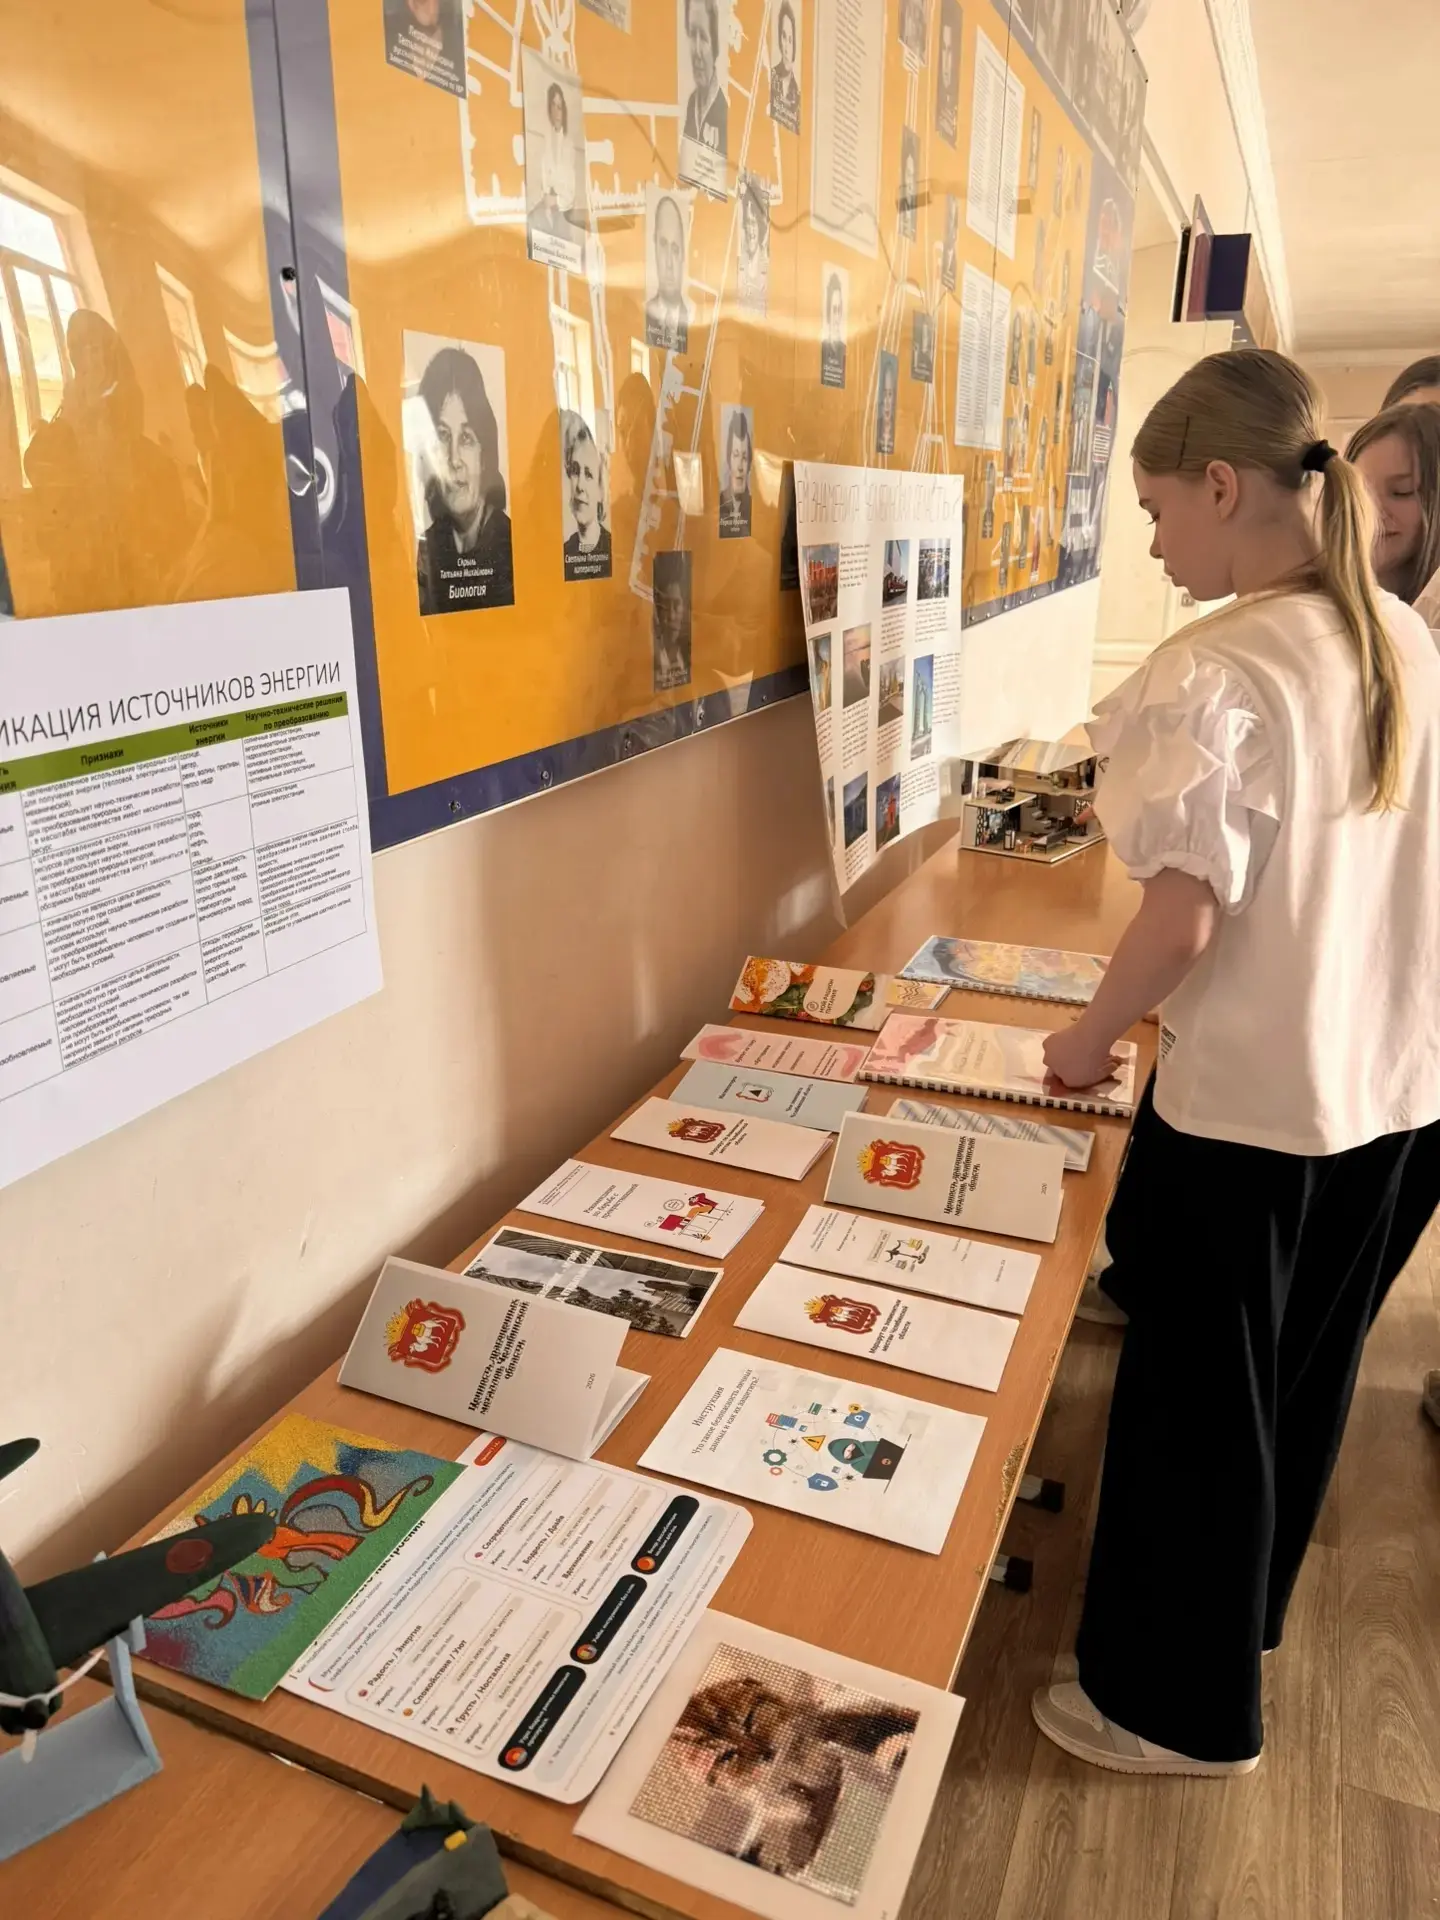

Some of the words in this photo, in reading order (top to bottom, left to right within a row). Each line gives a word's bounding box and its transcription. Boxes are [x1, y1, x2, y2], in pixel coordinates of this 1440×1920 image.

[440, 569, 462, 578] Татьяна
[463, 568, 494, 577] Михайловна
[457, 558, 476, 568] Скрыль
[449, 585, 486, 598] Биология
[109, 676, 255, 727] ИСТОЧНИКОВ
[261, 662, 341, 695] ЭНЕРГИИ
[245, 700, 313, 723] Научно-технические
[315, 694, 342, 707] решения
[263, 721, 271, 730] по
[273, 709, 329, 729] преобразованию
[188, 718, 228, 735] Источники
[195, 731, 225, 747] энергии
[80, 747, 123, 767] Признаки
[24, 798, 36, 808] для
[39, 789, 73, 804] получения
[31, 813, 56, 826] человек
[59, 804, 92, 819] использует
[94, 789, 149, 810] научно-технические
[40, 827, 76, 842] масштабах
[78, 814, 120, 832] человечества
[123, 809, 141, 819] имеют
[41, 814, 89, 833] преобразования
[91, 806, 121, 820] природных
[197, 895, 231, 914] температуры
[818, 1000, 827, 1012] МОЙ
[823, 978, 834, 1000] РАЦИОН
[824, 988, 838, 1014] ПИТАНИЯ
[596, 1195, 617, 1211] борьбе
[881, 1333, 894, 1351] местам
[888, 1305, 908, 1334] Челябинской
[896, 1320, 911, 1340] области
[467, 1362, 494, 1412] Ценность
[487, 1297, 520, 1365] драгоценных
[868, 1331, 886, 1354] Маршрут
[479, 1364, 505, 1415] металлов
[495, 1299, 530, 1366] Челябинской
[585, 1372, 596, 1389] 2026
[735, 1376, 761, 1406] защитить?
[690, 1385, 727, 1427] Инструкция
[690, 1442, 705, 1454] Что
[699, 1426, 716, 1443] такое
[709, 1388, 740, 1426] безопасность
[734, 1368, 754, 1389] личных
[725, 1413, 737, 1424] как
[731, 1405, 742, 1413] их
[707, 1429, 728, 1452] данных
[480, 1495, 529, 1550] Сосредоточенность
[521, 1536, 548, 1564] Бодрость
[546, 1514, 565, 1533] Драйв
[561, 1539, 595, 1579] Вдохновение
[366, 1656, 395, 1686] Радость
[395, 1624, 423, 1653] Энергия
[411, 1658, 452, 1705] Спокойствие
[451, 1639, 467, 1654] Уют
[454, 1698, 479, 1724] Грусть
[477, 1651, 512, 1693] Ностальгия
